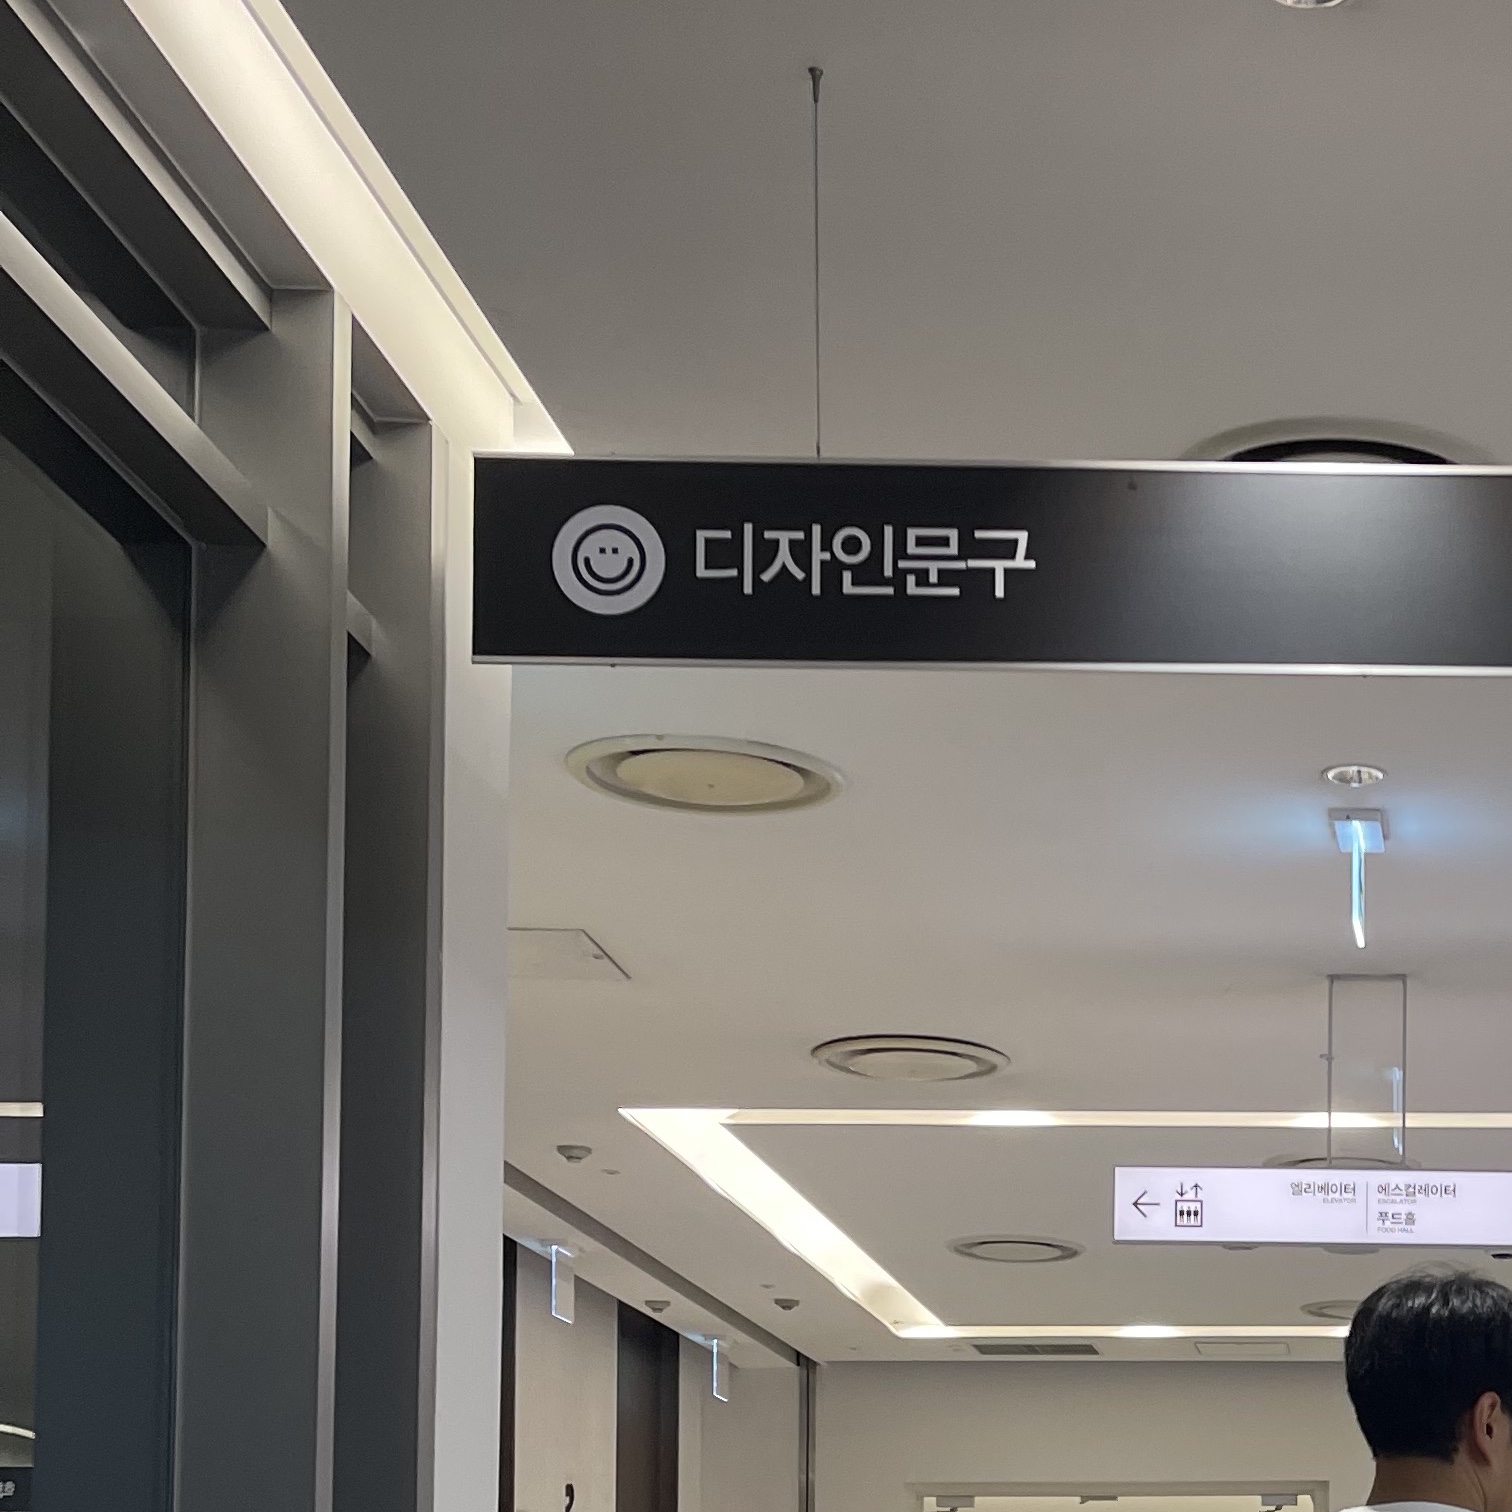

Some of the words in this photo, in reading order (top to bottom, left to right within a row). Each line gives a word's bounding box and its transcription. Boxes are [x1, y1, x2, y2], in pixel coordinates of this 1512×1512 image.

[695, 522, 1036, 599] 디자인문구
[1290, 1181, 1357, 1197] 엘리베이터
[1377, 1182, 1457, 1198] 에스컬레이터
[1377, 1211, 1416, 1226] 푸드홀
